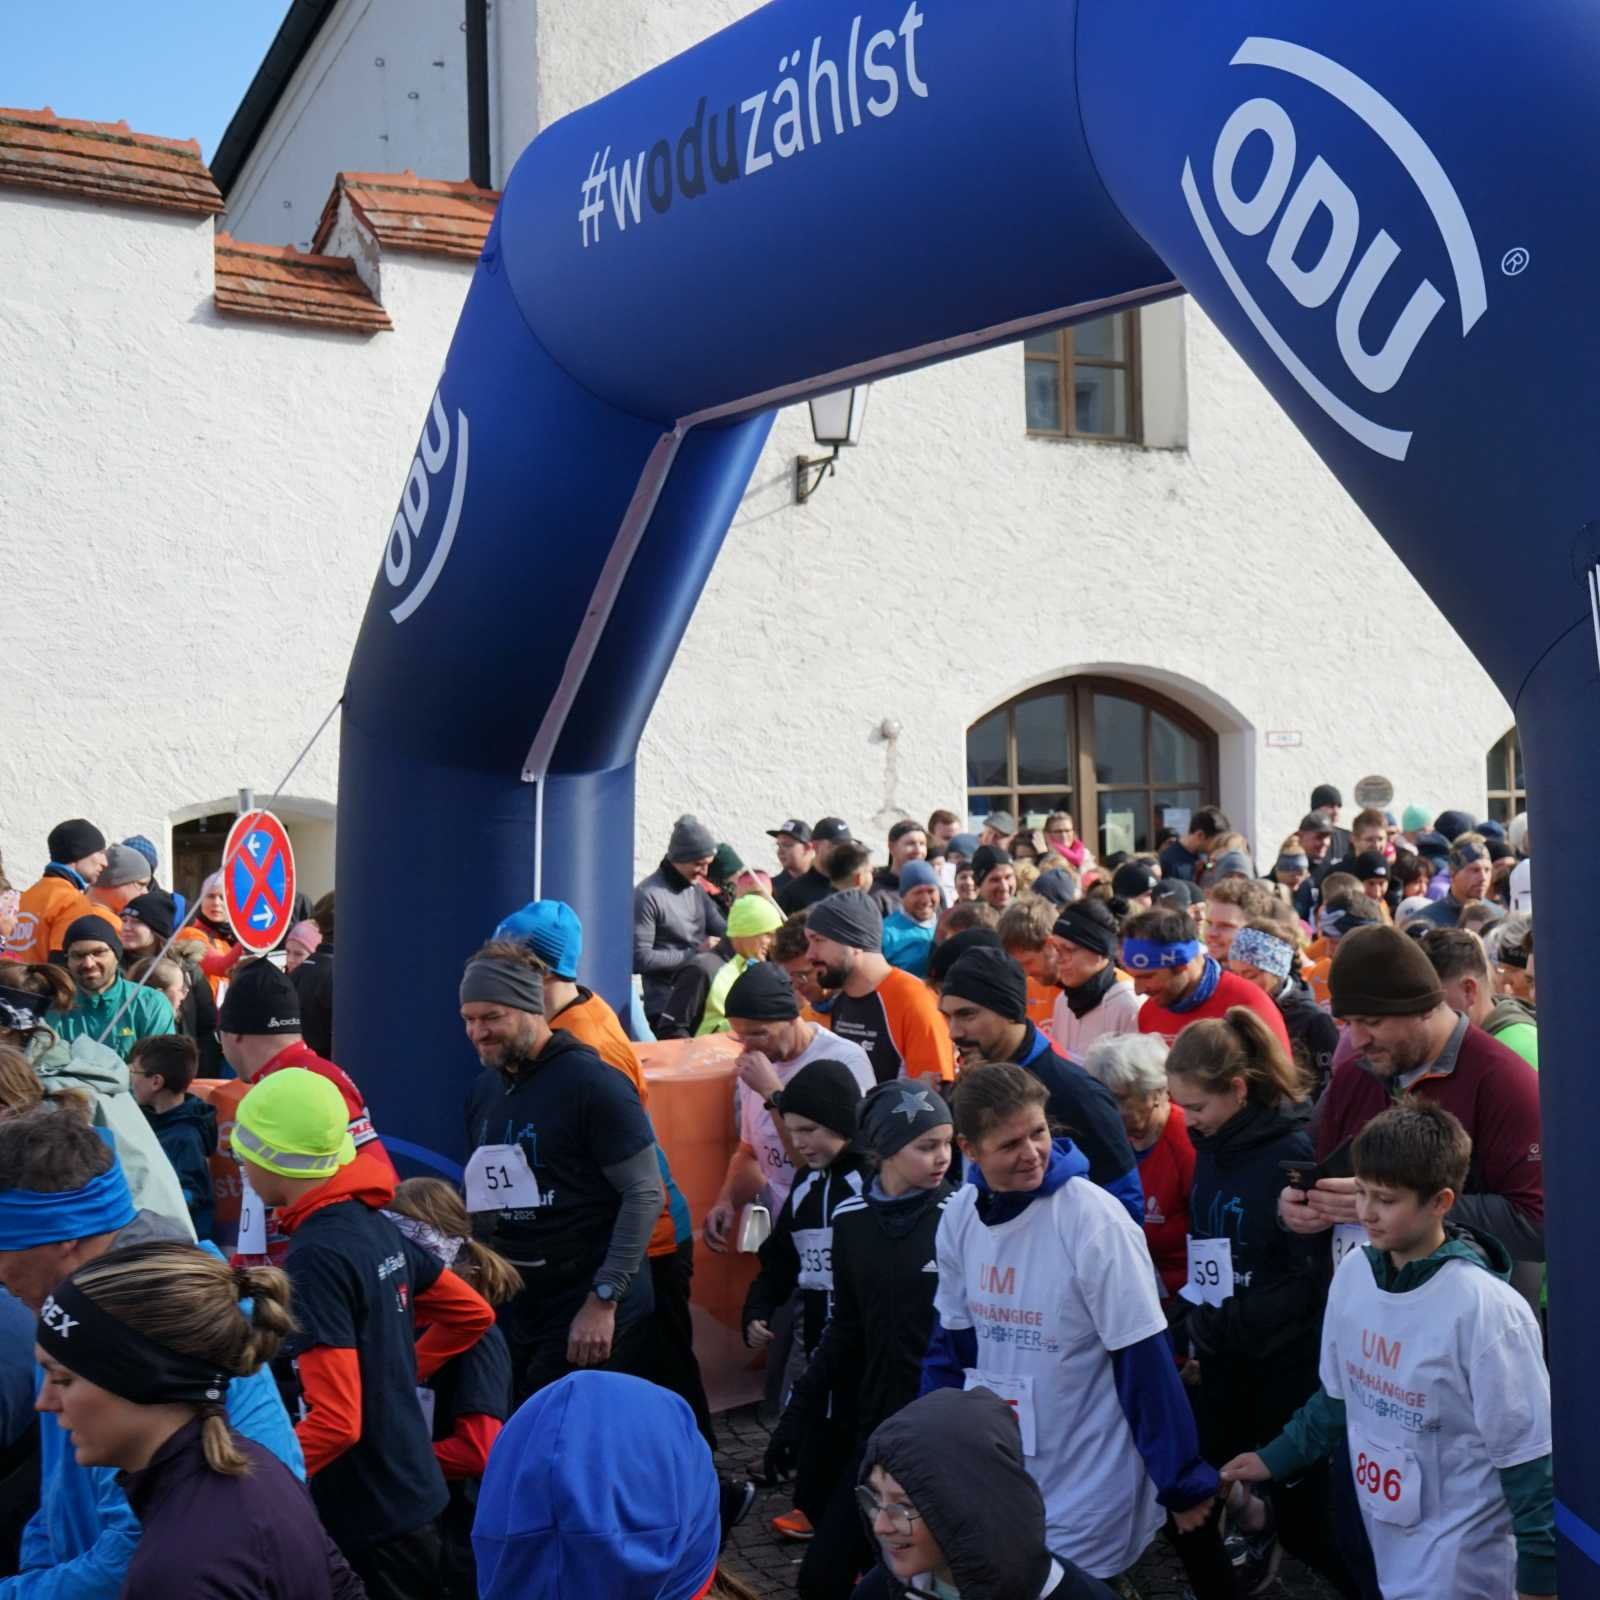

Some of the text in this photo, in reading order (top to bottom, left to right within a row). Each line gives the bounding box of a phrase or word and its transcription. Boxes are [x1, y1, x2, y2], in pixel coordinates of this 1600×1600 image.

[578, 1, 928, 248] #woduzählst
[1212, 97, 1446, 394] ODU
[485, 1165, 514, 1190] 51
[1194, 1260, 1220, 1286] 59
[1361, 1327, 1402, 1372] UM
[1356, 1452, 1402, 1502] 896
